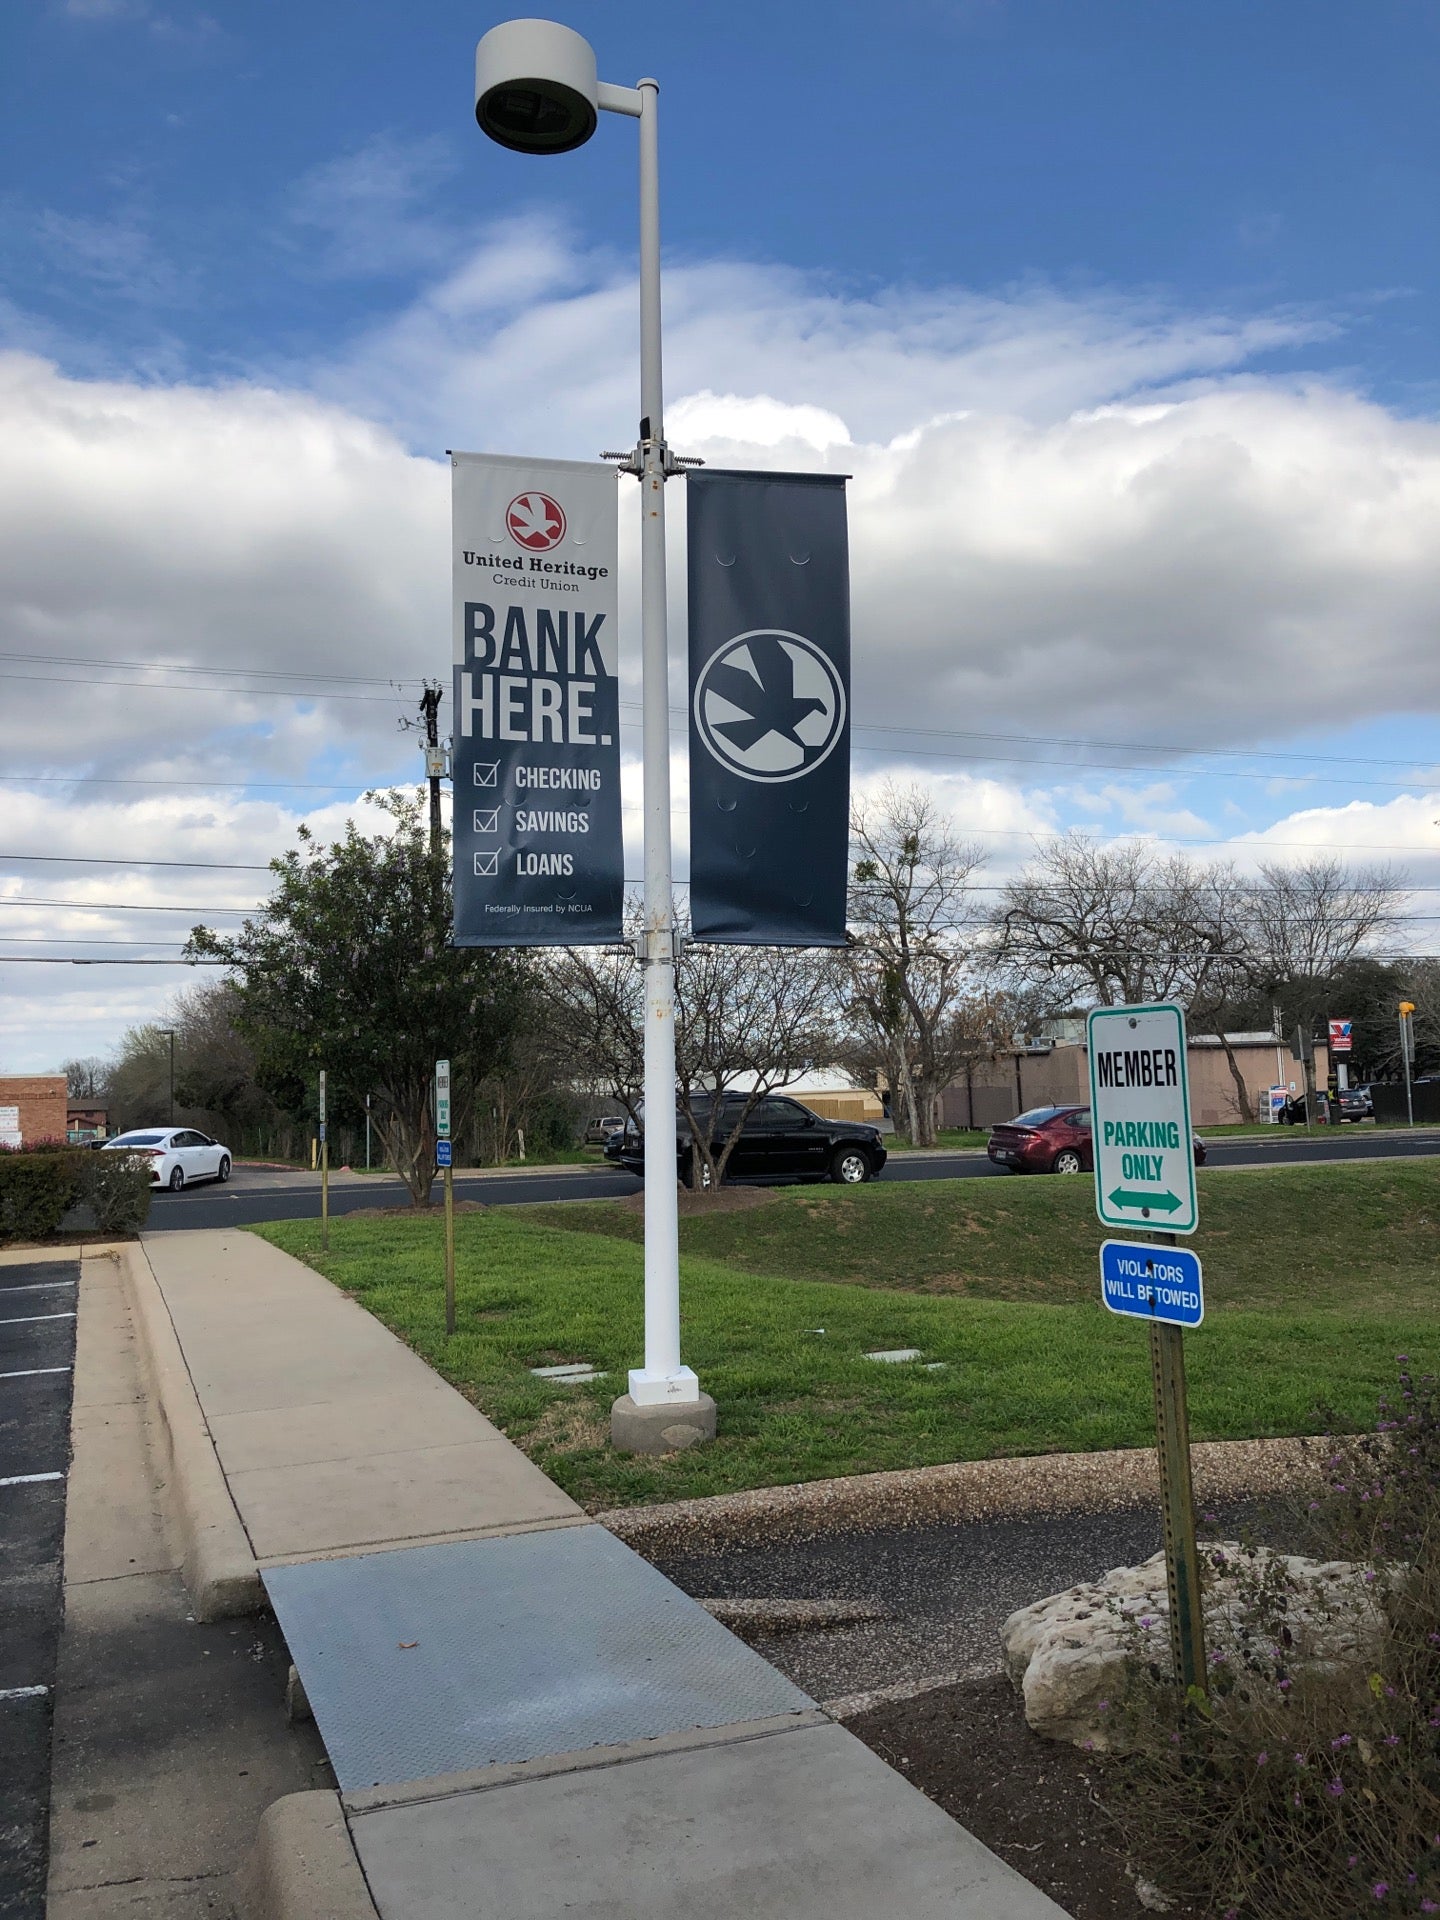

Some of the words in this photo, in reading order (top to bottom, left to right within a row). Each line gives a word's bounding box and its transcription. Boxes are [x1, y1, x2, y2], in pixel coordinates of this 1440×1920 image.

[463, 551, 523, 570] United
[529, 558, 609, 580] Heritage
[492, 573, 536, 589] Credit
[540, 579, 580, 592] Union
[464, 602, 607, 677] BANK
[461, 672, 612, 745] HERE.
[515, 766, 601, 790] CHECKING
[515, 811, 590, 833] SAVINGS
[516, 853, 574, 876] LOANS
[485, 904, 521, 914] Federally
[523, 904, 553, 913] Insured
[555, 904, 566, 914] by
[568, 904, 593, 913] NCUA
[1097, 1049, 1177, 1088] MEMBER
[1103, 1121, 1180, 1149] PARKING
[1121, 1153, 1163, 1182] ONLY
[1116, 1258, 1184, 1284] VIOLATORS
[1106, 1279, 1135, 1299] WILL
[1137, 1284, 1153, 1301] BE
[1155, 1287, 1199, 1309] TOWED
